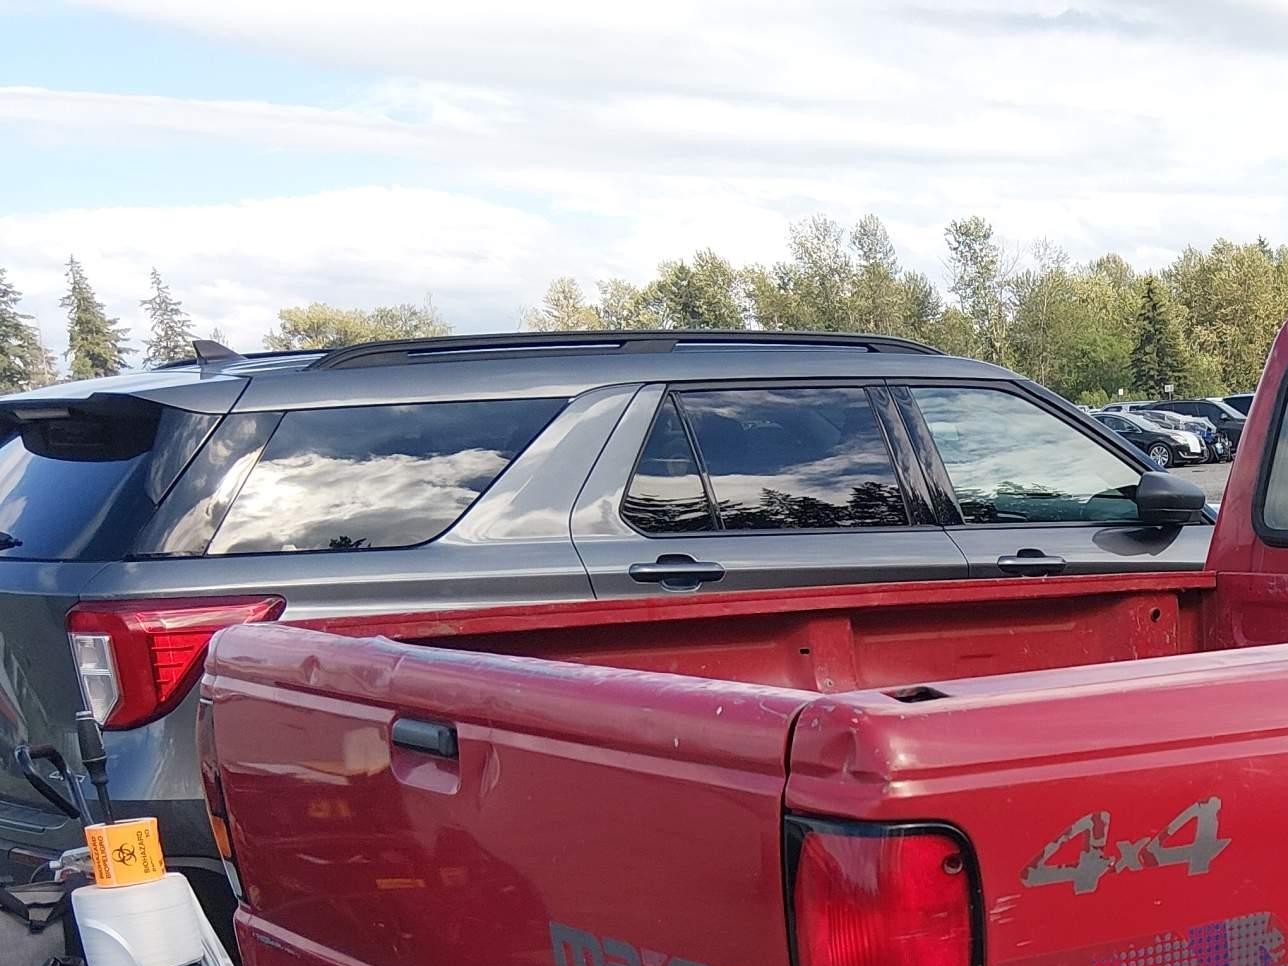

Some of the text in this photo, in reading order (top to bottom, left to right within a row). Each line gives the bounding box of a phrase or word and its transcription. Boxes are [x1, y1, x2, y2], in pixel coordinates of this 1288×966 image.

[98, 835, 112, 879] BIOPELIGRO
[136, 830, 150, 874] BIOHAZARD
[1022, 797, 1232, 894] 4x4
